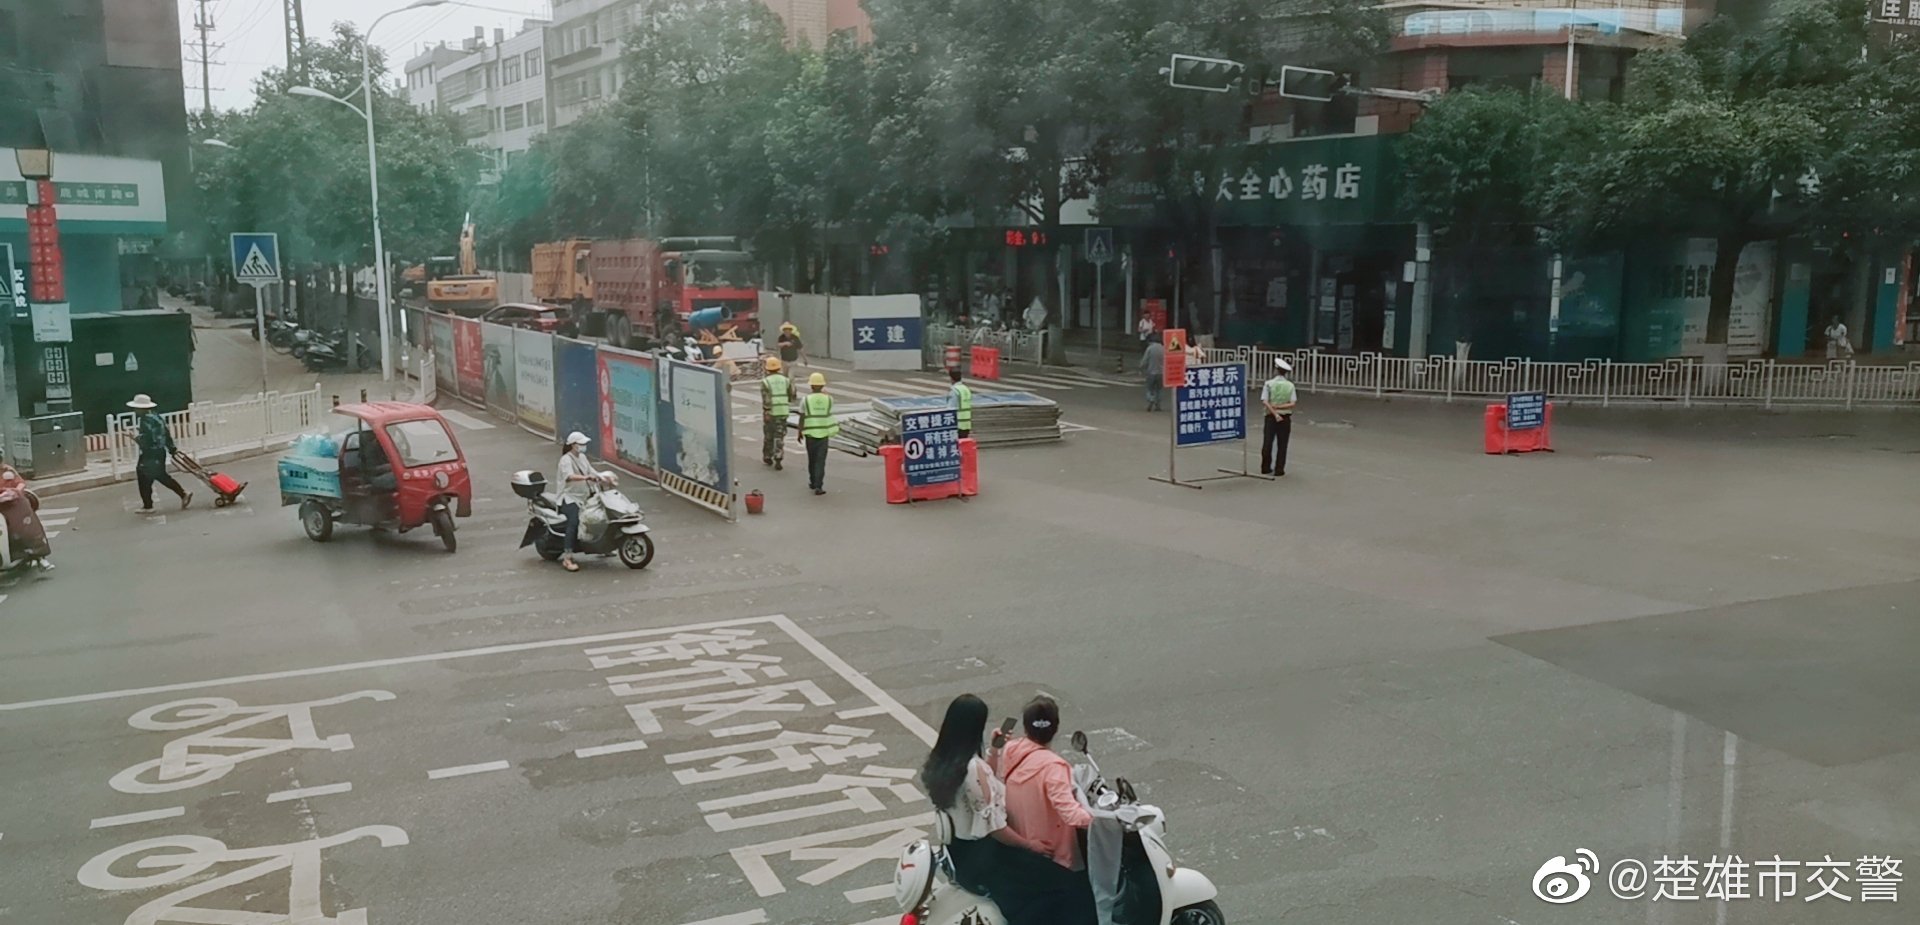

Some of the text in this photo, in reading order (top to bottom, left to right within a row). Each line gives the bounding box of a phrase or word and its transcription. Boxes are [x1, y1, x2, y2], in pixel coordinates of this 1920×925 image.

[857, 324, 905, 344] 交建
[1183, 366, 1239, 388] 交警提示
[905, 412, 955, 431] 交警提示
[925, 429, 959, 445] 所有车辆
